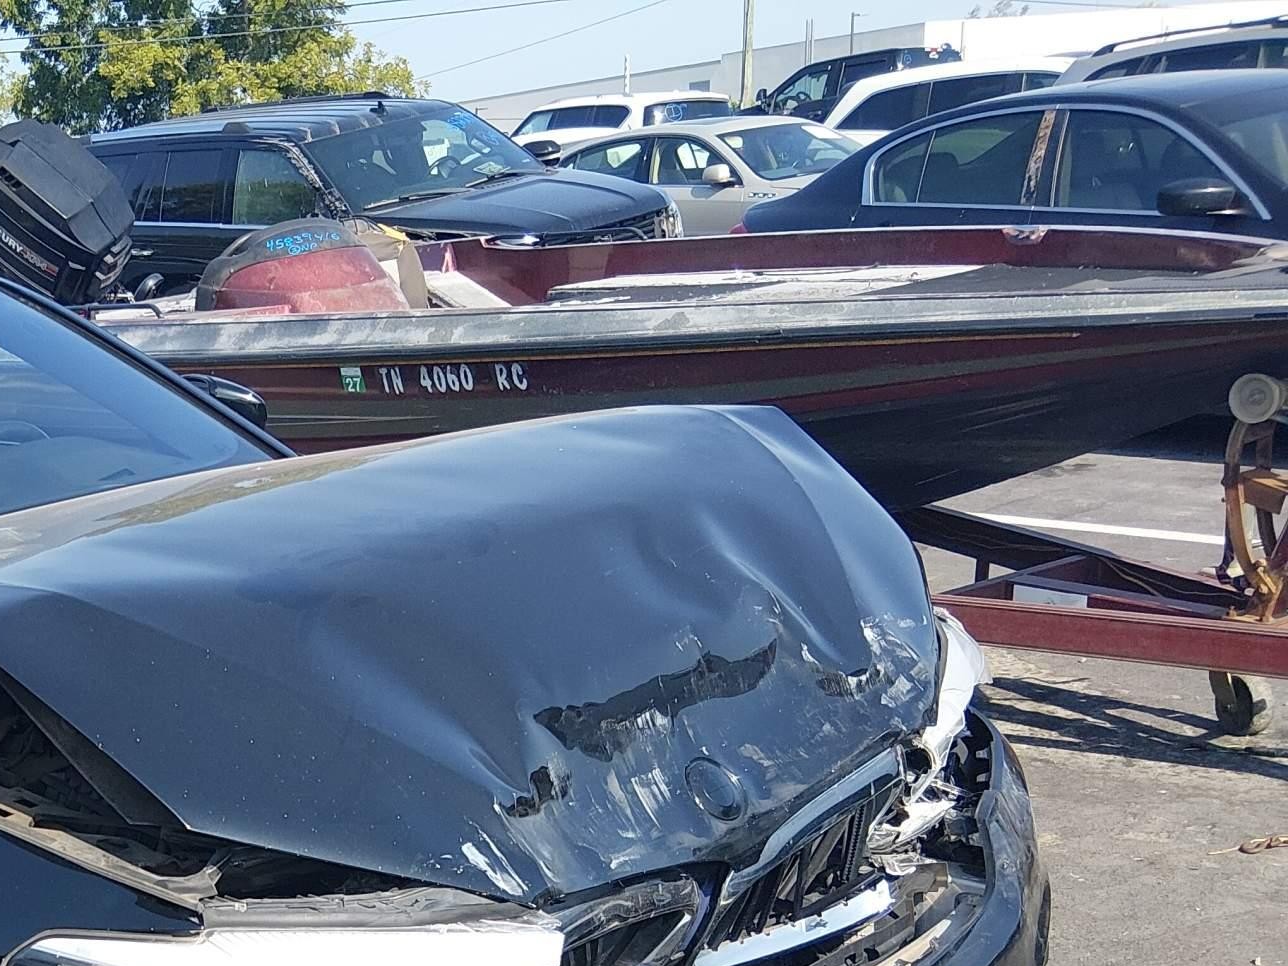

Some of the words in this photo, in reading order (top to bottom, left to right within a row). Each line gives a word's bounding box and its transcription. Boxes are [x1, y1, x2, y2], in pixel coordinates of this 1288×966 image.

[345, 377, 361, 392] 27
[379, 367, 404, 395] TN
[419, 364, 474, 393] 4060
[495, 362, 528, 391] RC
